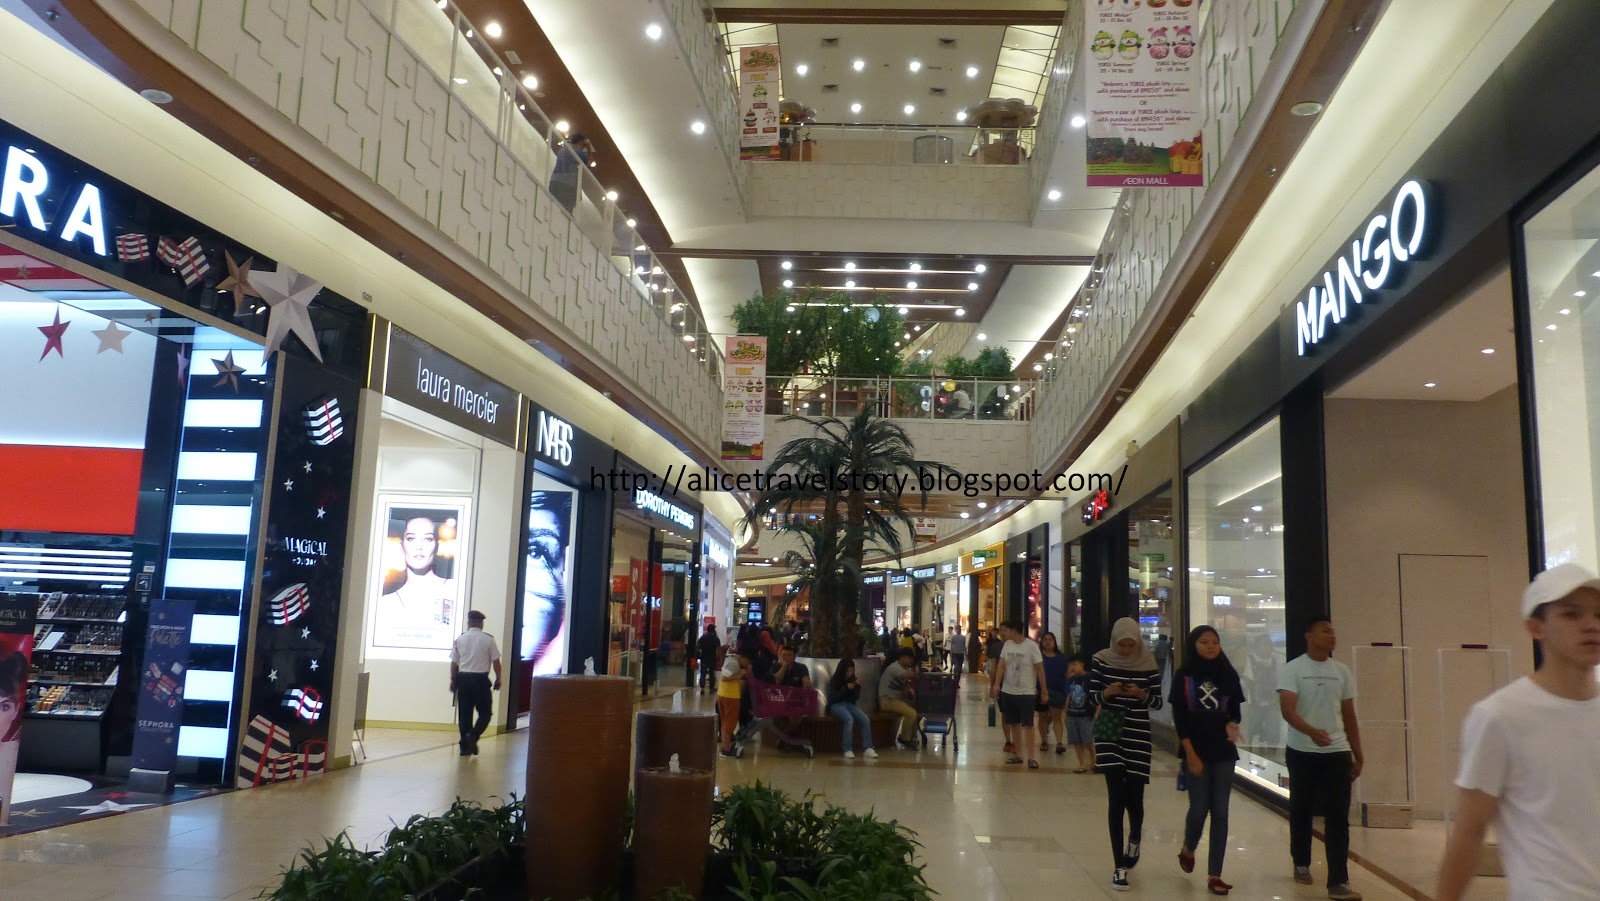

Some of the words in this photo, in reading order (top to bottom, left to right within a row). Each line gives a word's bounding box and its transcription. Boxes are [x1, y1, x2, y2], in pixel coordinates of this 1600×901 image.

[0, 145, 107, 257] RA
[1145, 177, 1169, 185] MALL
[1296, 180, 1425, 356] MANGO
[416, 358, 451, 403] laura
[453, 384, 500, 424] mercier
[635, 487, 671, 518] DOROTHY
[670, 504, 695, 530] PERKINS
[138, 719, 174, 729] SEPHORA
